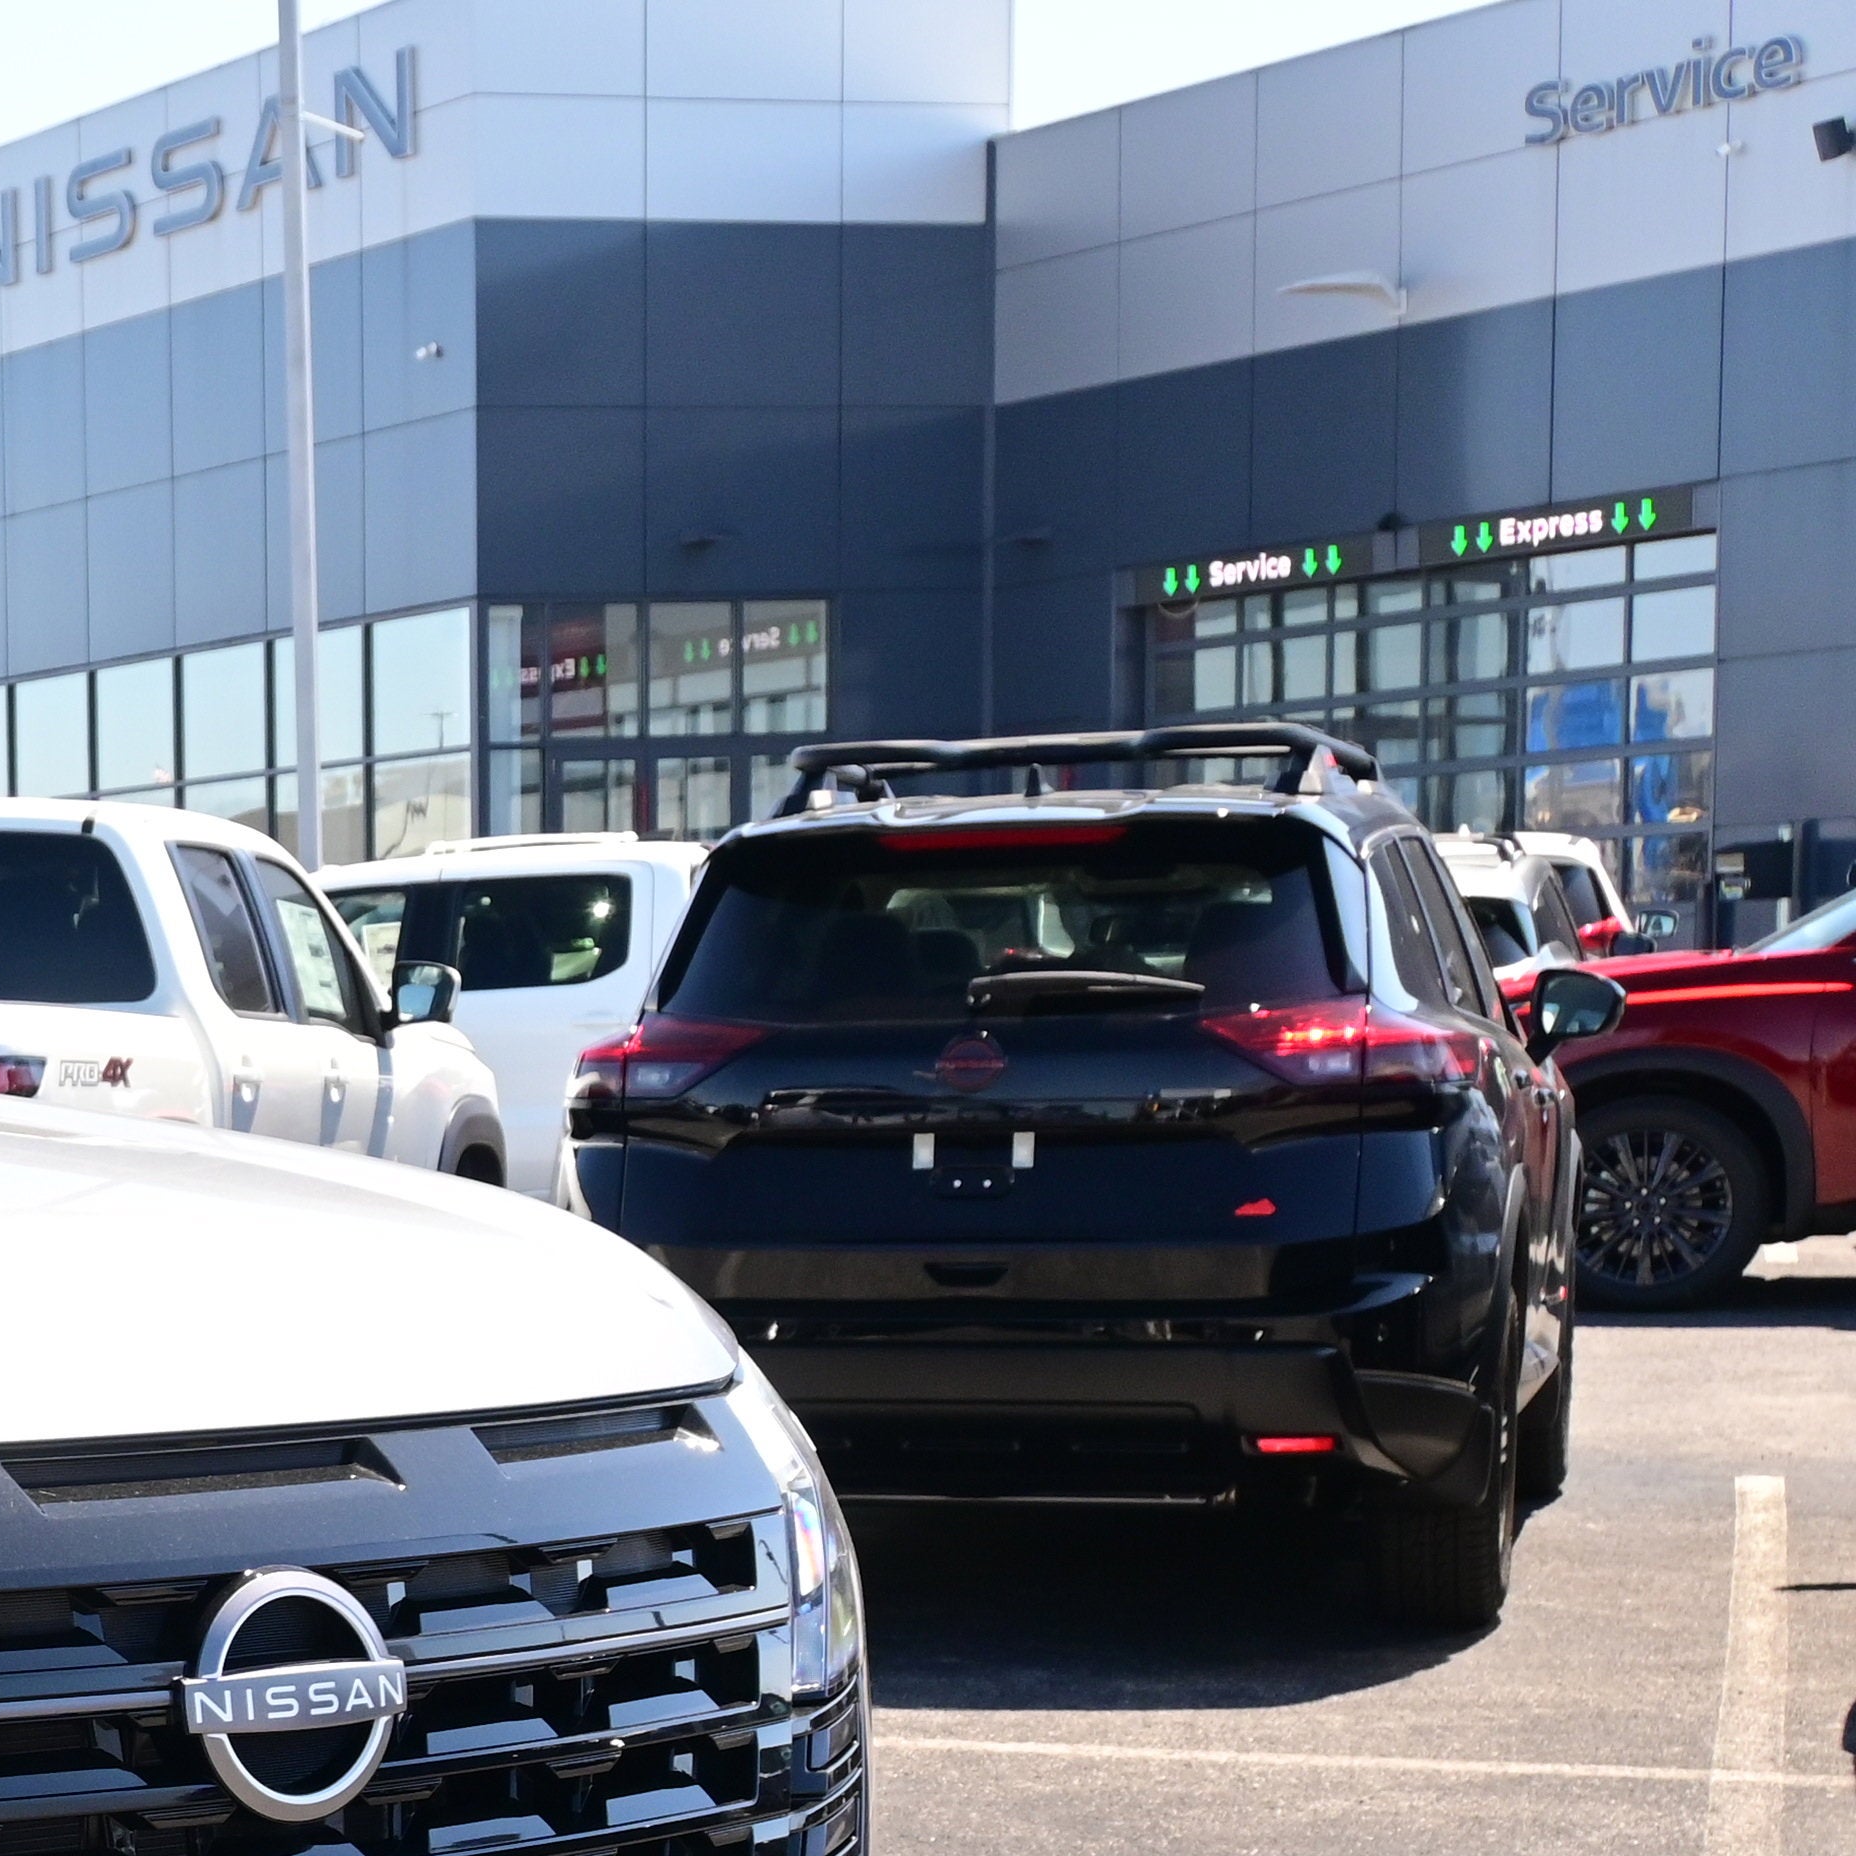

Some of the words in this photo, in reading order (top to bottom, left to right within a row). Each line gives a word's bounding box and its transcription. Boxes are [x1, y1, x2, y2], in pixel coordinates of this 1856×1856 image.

[1524, 35, 1801, 146] Service
[1499, 509, 1603, 547] Express
[1209, 552, 1291, 587] Service
[58, 1056, 133, 1087] PRO-4X
[193, 1671, 404, 1724] NISSAN
